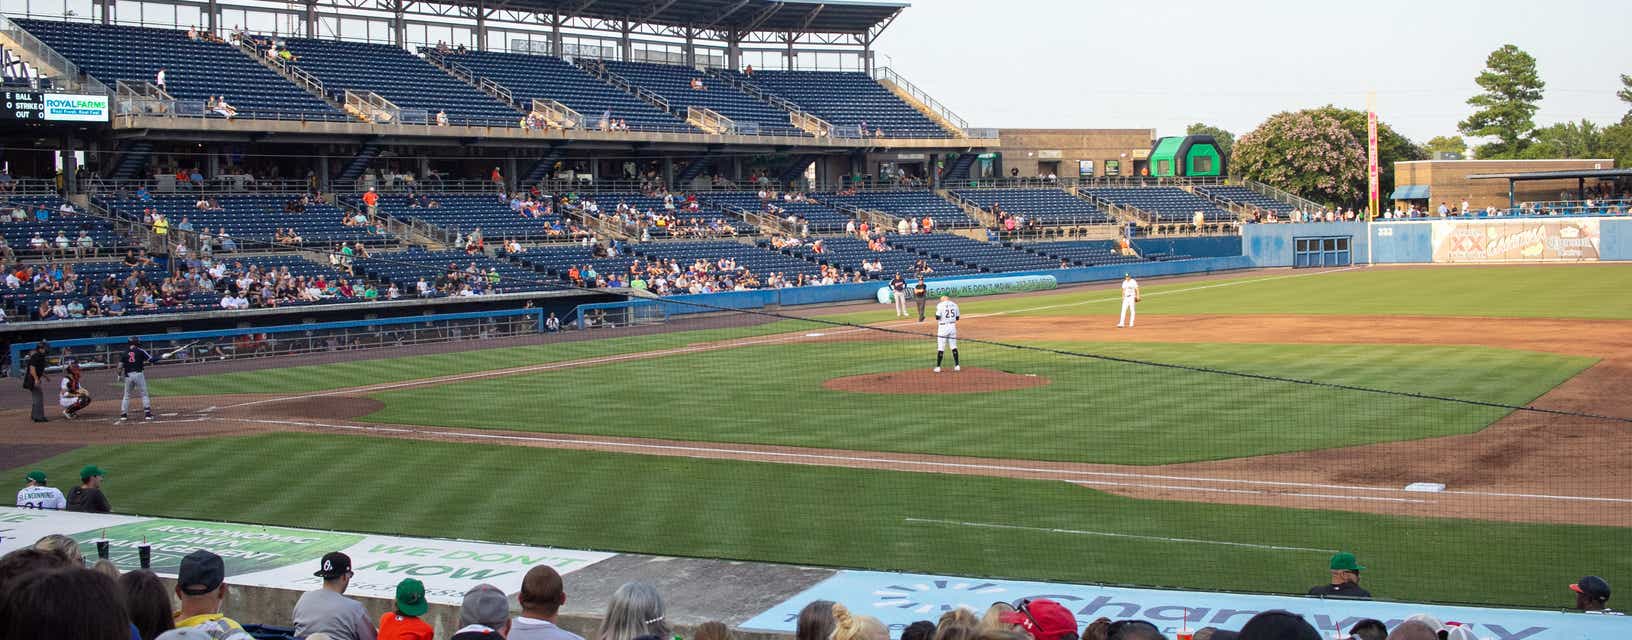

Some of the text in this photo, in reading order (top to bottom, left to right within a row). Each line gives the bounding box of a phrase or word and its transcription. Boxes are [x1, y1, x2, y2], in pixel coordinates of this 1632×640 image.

[16, 93, 32, 101] BALL
[15, 102, 38, 110] STRIKE
[944, 309, 956, 319] 25
[149, 525, 321, 544] AGRONOMIC
[366, 542, 590, 569] WE DON'T
[355, 560, 517, 581] MOW
